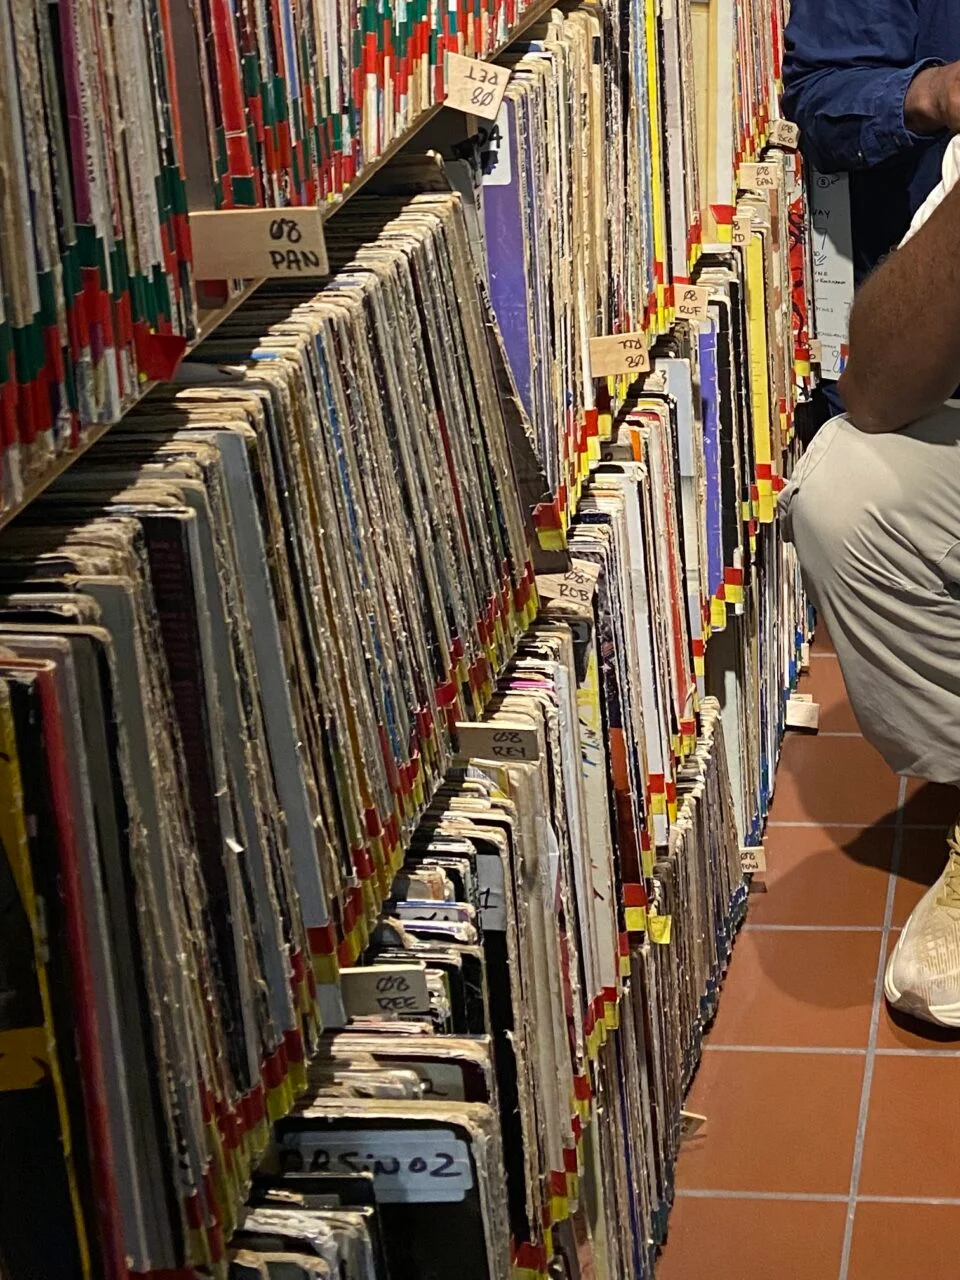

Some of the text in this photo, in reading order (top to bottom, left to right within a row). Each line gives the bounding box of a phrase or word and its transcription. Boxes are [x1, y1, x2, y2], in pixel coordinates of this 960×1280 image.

[464, 66, 499, 87] PET
[269, 250, 320, 270] PAN
[678, 305, 702, 317] RUF
[558, 583, 590, 601] ROB
[491, 746, 526, 757] REY
